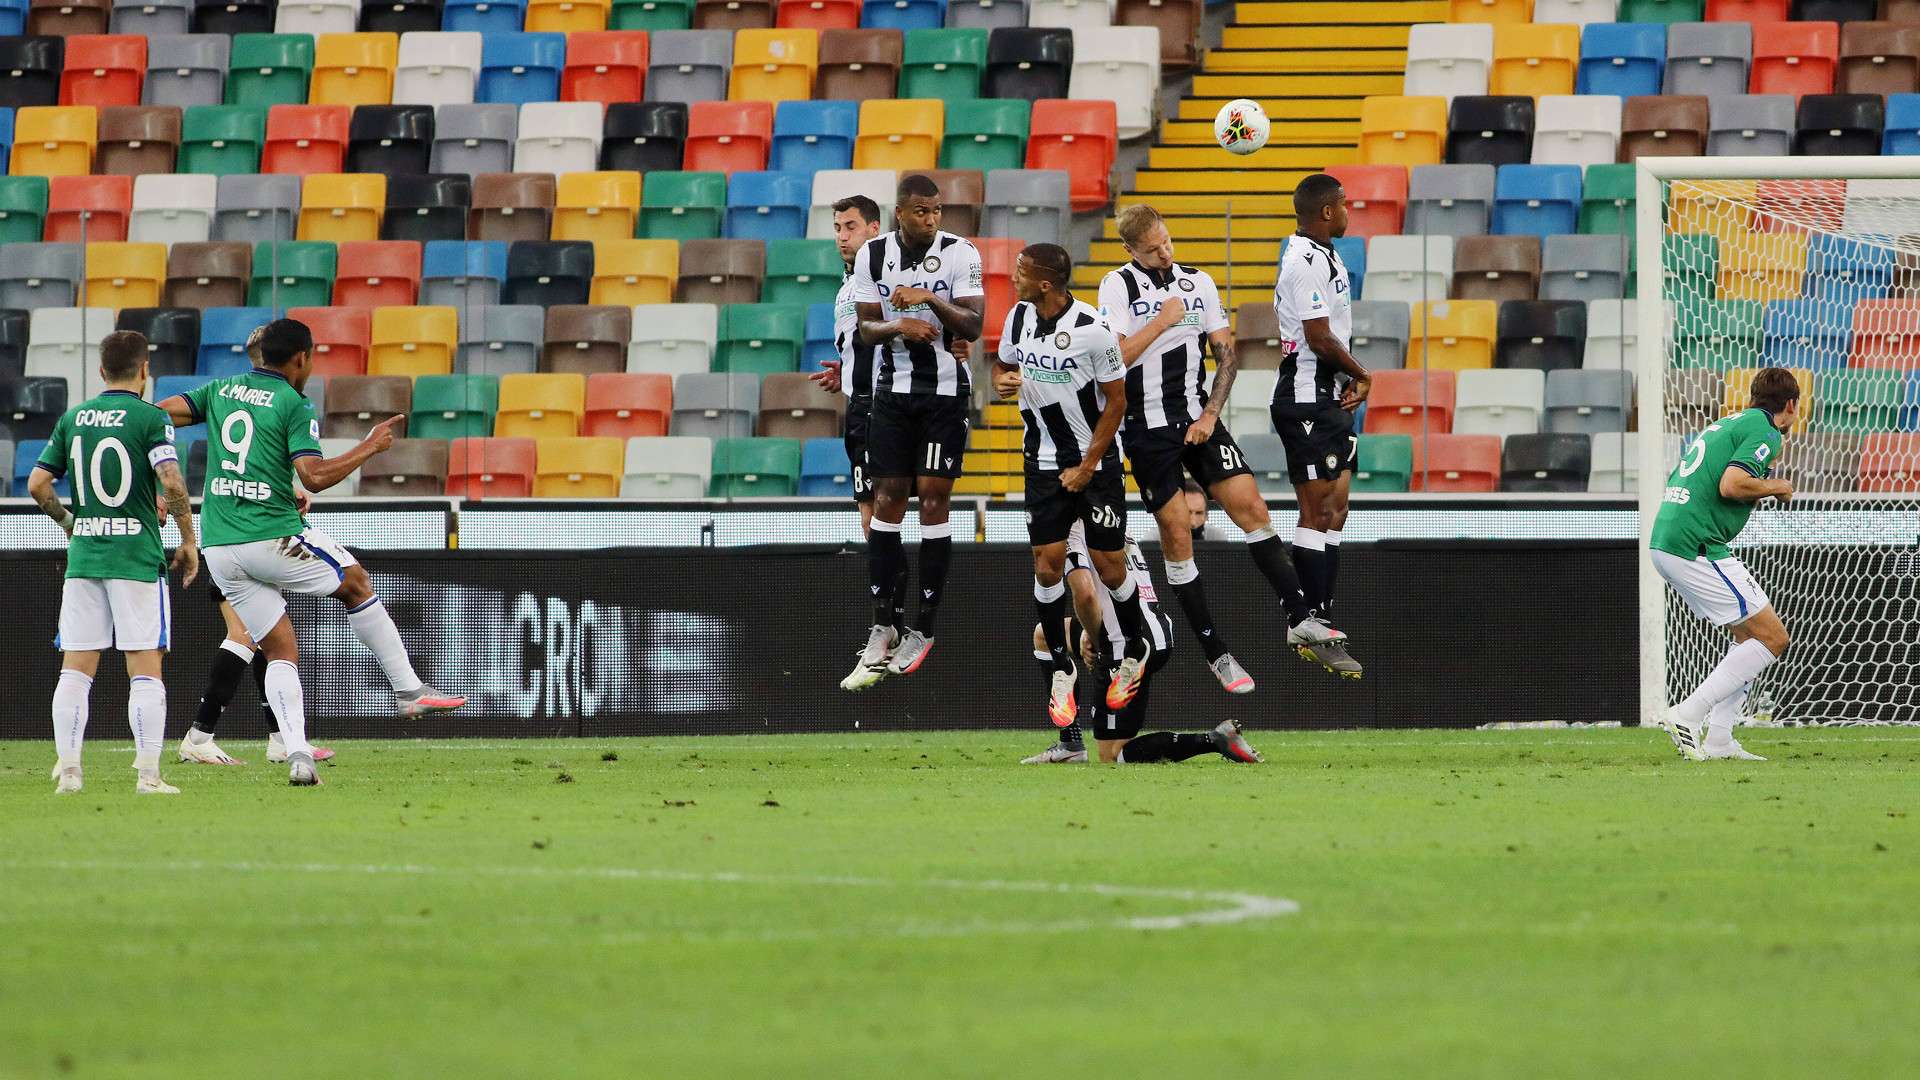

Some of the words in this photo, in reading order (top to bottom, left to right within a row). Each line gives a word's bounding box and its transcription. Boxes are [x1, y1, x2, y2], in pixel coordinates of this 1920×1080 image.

[1132, 297, 1205, 317] DAIA
[1016, 348, 1079, 371] DACIA
[75, 409, 127, 428] GOMEZ
[221, 409, 254, 475] 9
[1348, 435, 1358, 462] 7
[925, 442, 941, 470] 11
[1219, 444, 1243, 470] 91
[69, 435, 132, 508] 10
